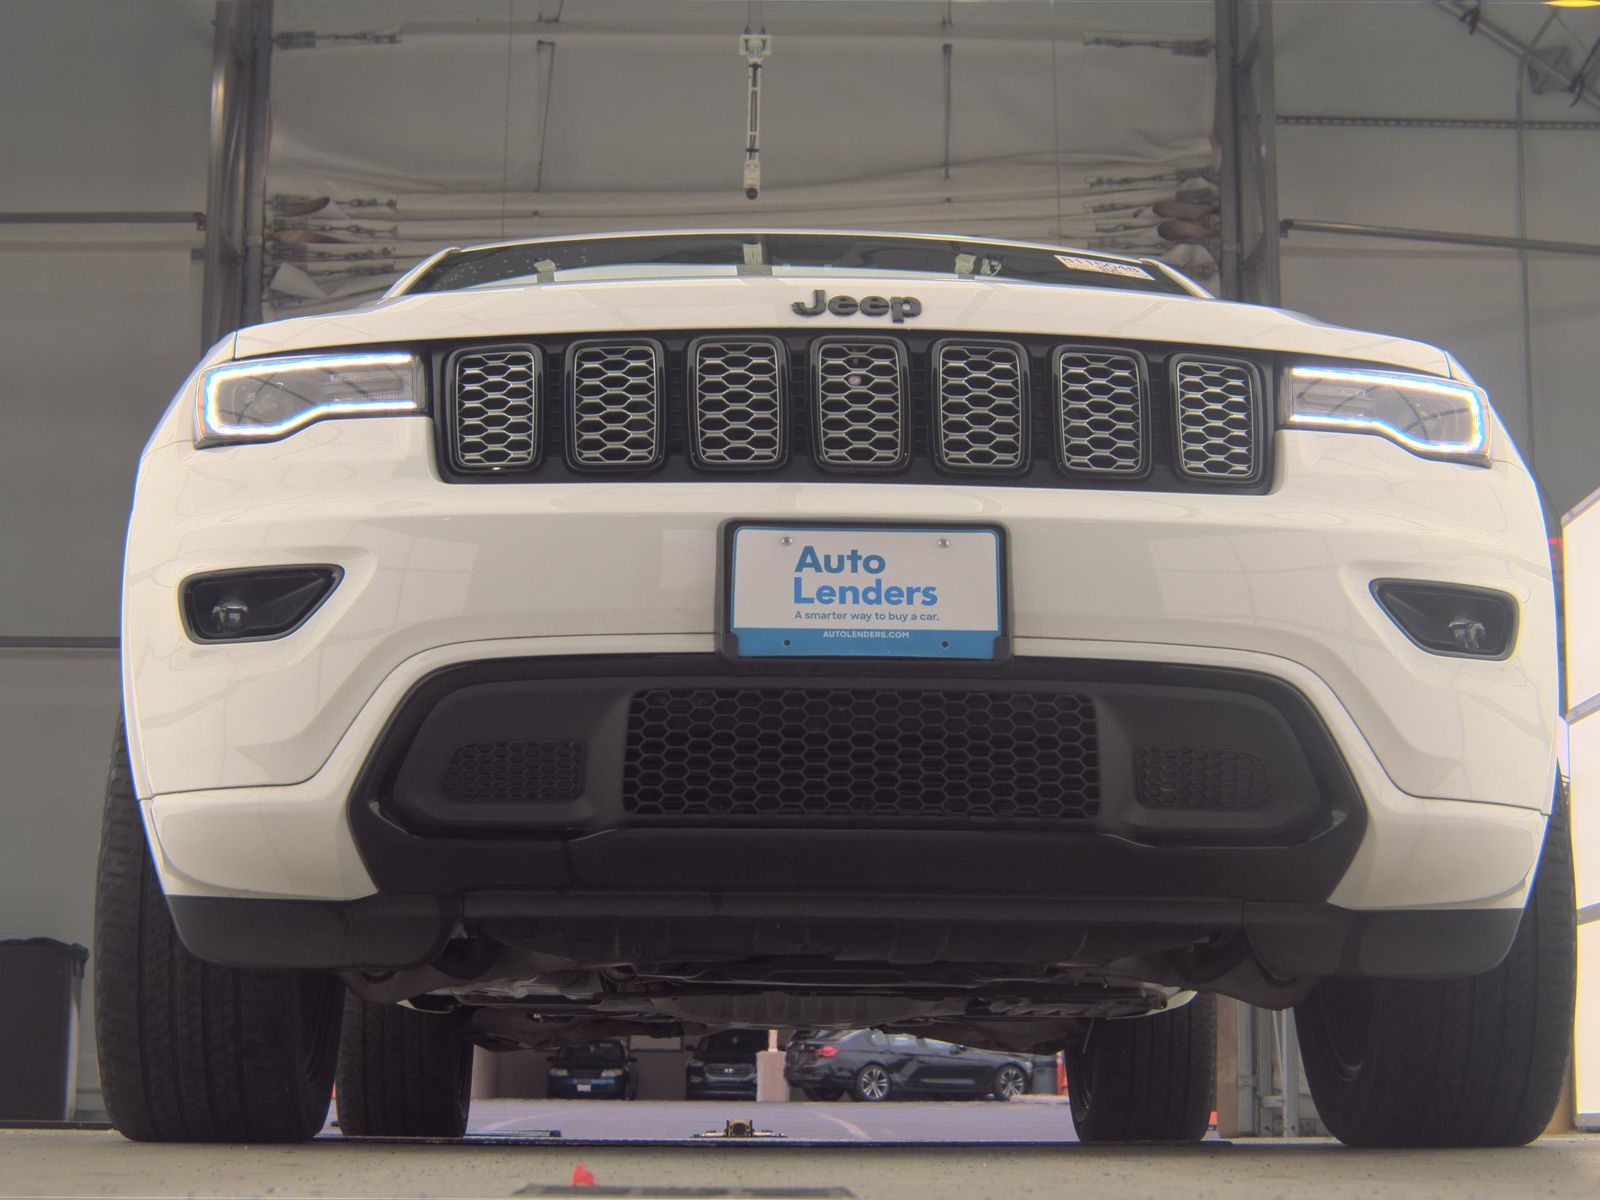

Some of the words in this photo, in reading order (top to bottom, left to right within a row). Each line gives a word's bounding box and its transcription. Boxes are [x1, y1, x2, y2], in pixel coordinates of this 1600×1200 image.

[791, 289, 922, 323] Jeep
[794, 545, 886, 574] Auto
[793, 577, 938, 606] Lenders
[794, 610, 802, 619] A
[804, 611, 847, 620] smarter
[850, 613, 872, 622] way
[875, 612, 886, 621] to
[888, 611, 908, 622] buy
[823, 630, 910, 639] AUTOLENDERS.COM
